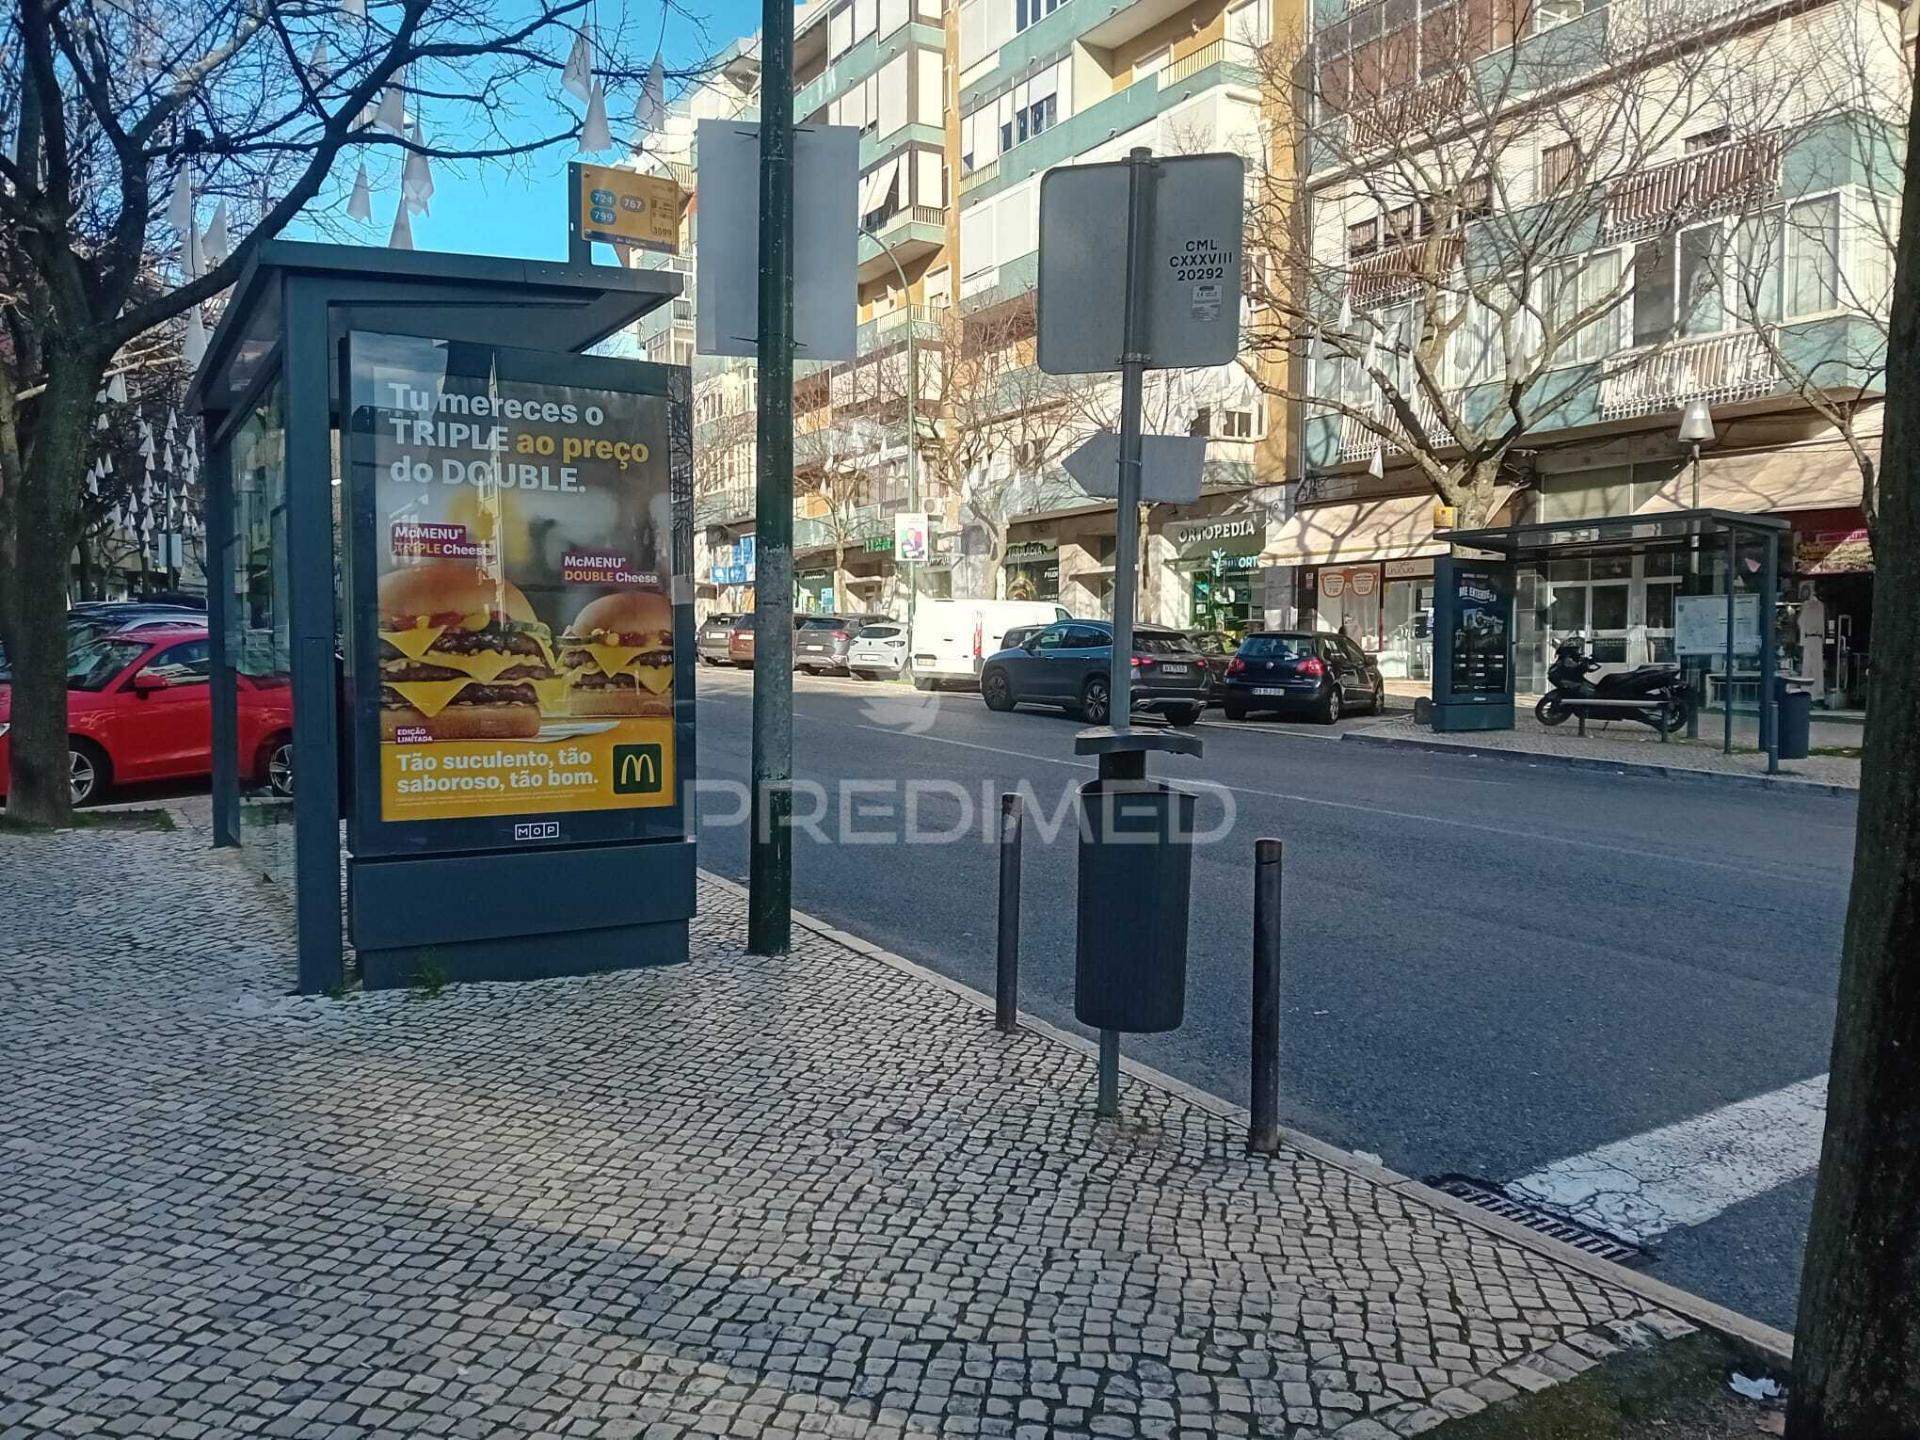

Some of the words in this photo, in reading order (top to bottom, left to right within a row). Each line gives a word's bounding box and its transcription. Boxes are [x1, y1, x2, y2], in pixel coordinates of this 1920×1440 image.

[594, 192, 613, 202] 724
[623, 200, 643, 210] 767
[594, 210, 614, 222] 799
[1185, 239, 1218, 251] CML
[1169, 252, 1232, 268] CXXXVIII
[1177, 267, 1223, 281] 20292
[387, 382, 430, 413] Tu
[439, 392, 579, 424] mereces
[585, 406, 604, 426] o
[388, 417, 510, 452] TRIPLE
[516, 432, 556, 455] ao
[562, 437, 650, 470] preço
[390, 455, 434, 484] do
[442, 458, 587, 492] DOUBLE.
[1178, 519, 1255, 543] ORTOPEDIA
[394, 541, 441, 555] TRIPLE
[443, 543, 491, 556] Cheese
[564, 570, 614, 583] DOUBLE
[615, 571, 658, 584] Cheese
[397, 727, 426, 736] EDIÇÃO
[397, 735, 433, 744] LIMITADA
[396, 752, 438, 772] Tão
[442, 750, 555, 770] suculento,
[558, 747, 592, 766] tão
[396, 775, 506, 794] saboroso,
[510, 770, 544, 789] tão
[547, 770, 599, 787] bom.
[515, 822, 560, 841] MOP
